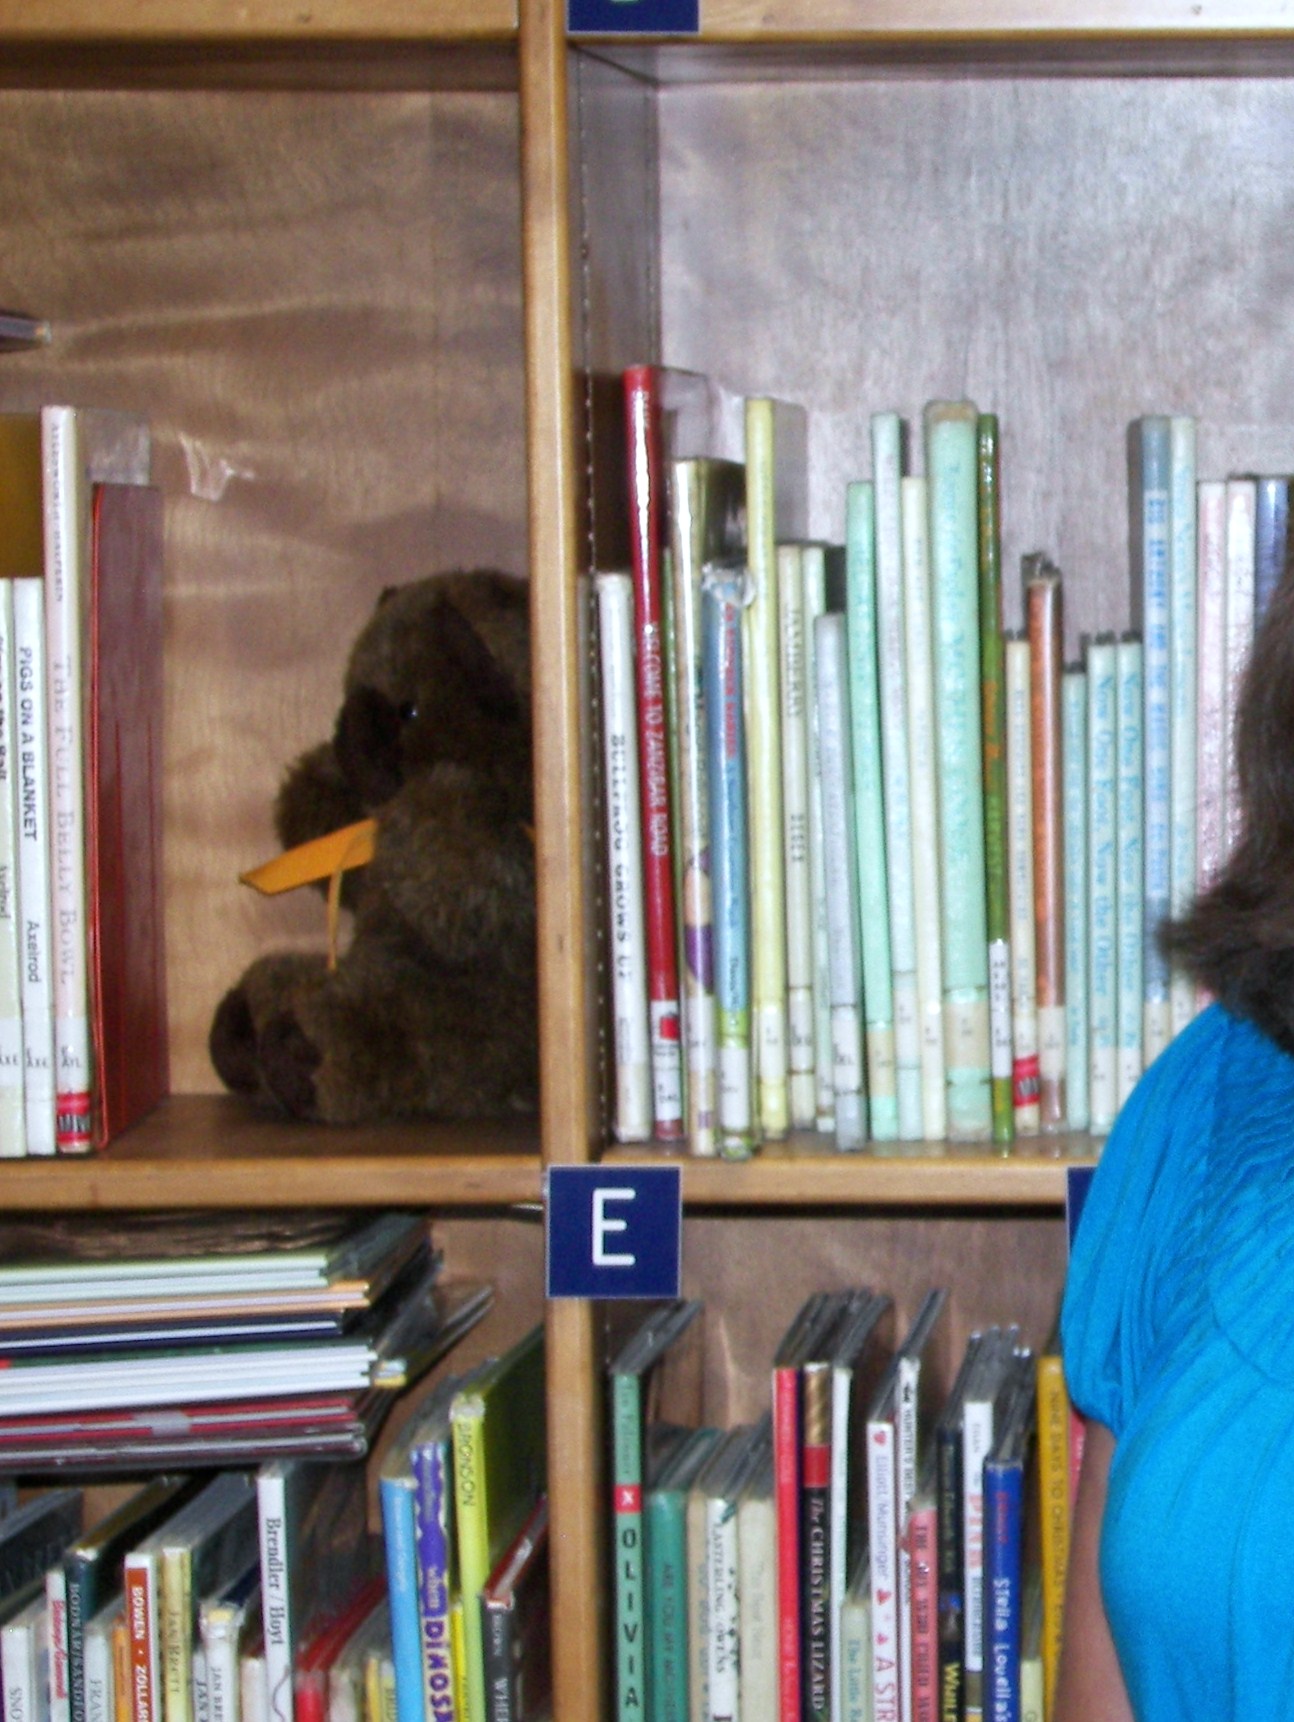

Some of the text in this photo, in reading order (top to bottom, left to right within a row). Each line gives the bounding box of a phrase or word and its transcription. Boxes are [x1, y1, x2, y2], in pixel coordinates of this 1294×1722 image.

[19, 645, 38, 842] PIGS ON A BLANKET
[54, 657, 78, 986] THE FULL BELLY BOWL
[26, 920, 41, 983] Axelrod
[592, 1187, 636, 1265] E
[1052, 1479, 1064, 1500] TO
[266, 1517, 284, 1591] Brendler
[811, 1527, 826, 1637] CHRISTMAS
[132, 1586, 146, 1640] BOWEN
[267, 1606, 286, 1646] Hoyt
[622, 1527, 639, 1708] OLIVIA
[195, 1679, 209, 1711] JAN
[211, 1666, 223, 1692] JAN
[811, 1641, 826, 1711] LIZARD
[875, 1655, 897, 1722] A STR
